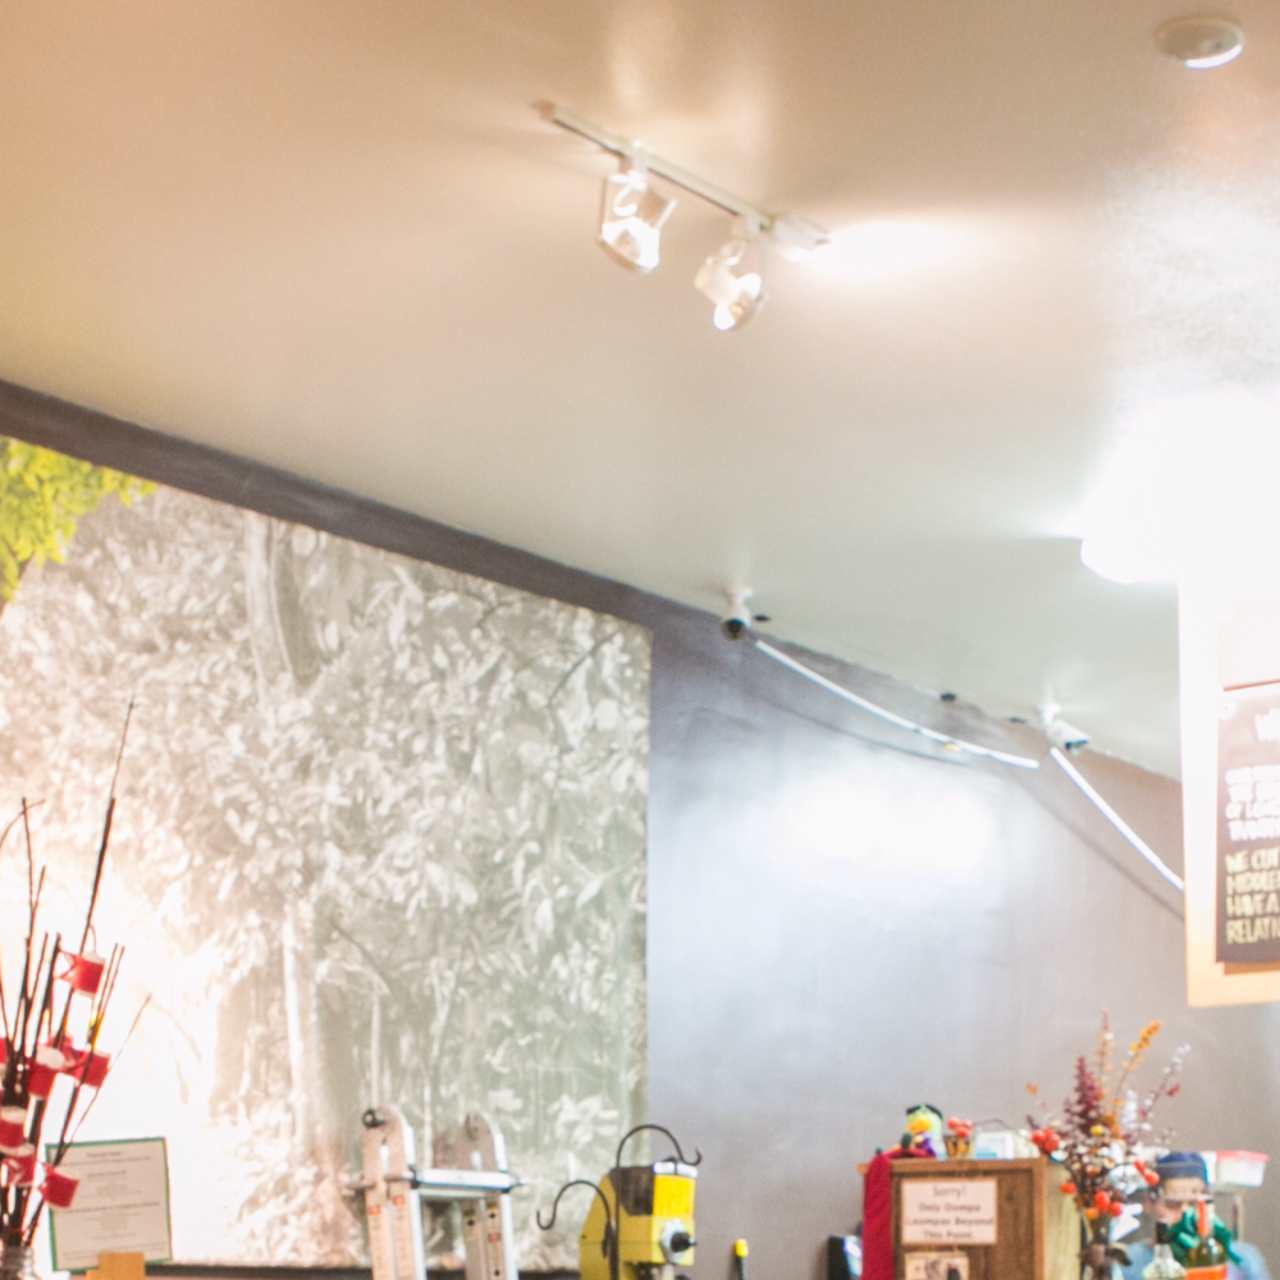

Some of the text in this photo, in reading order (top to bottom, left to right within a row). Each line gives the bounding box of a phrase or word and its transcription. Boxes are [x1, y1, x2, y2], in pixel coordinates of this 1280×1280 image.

[1225, 850, 1249, 873] WE
[1226, 892, 1267, 917] HAVE
[1267, 891, 1280, 915] A
